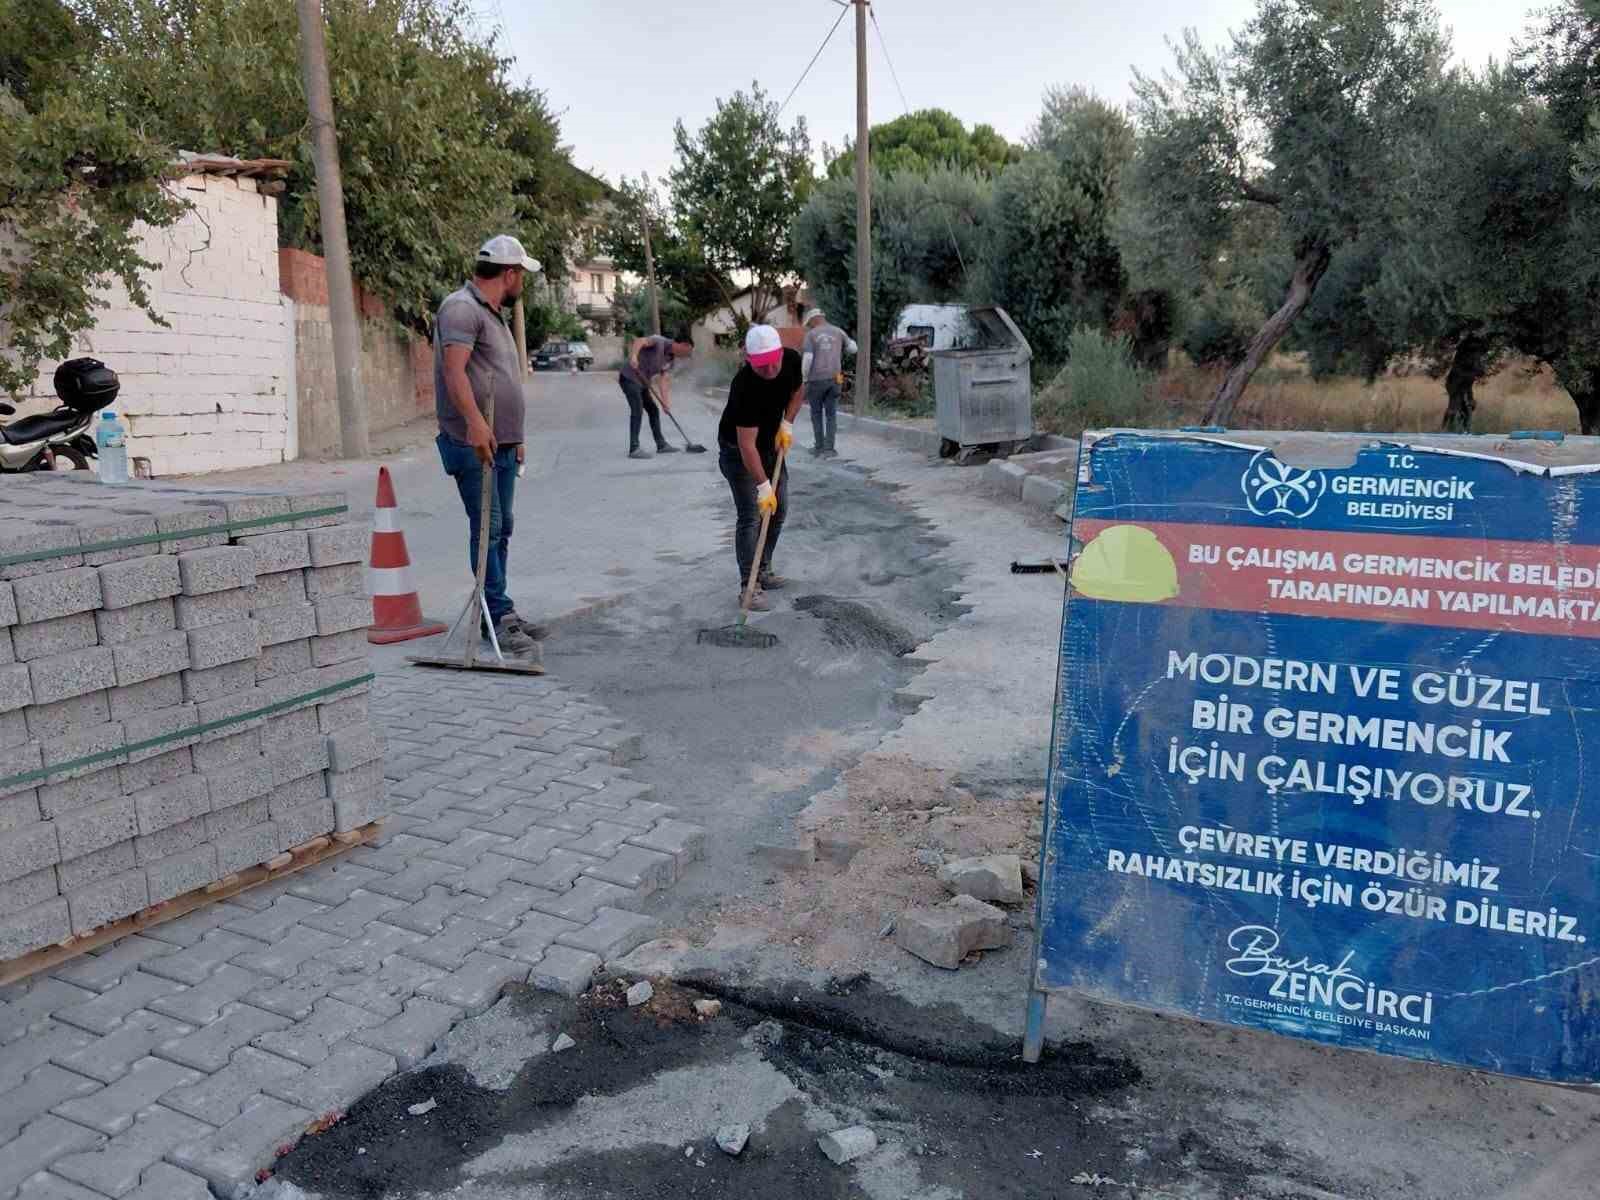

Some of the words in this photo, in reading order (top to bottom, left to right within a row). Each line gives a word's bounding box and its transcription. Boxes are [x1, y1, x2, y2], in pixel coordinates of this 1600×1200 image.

[1331, 476, 1475, 500] GERMENCİK
[1387, 454, 1420, 469] T.C.
[1347, 501, 1454, 521] BELEDİYESİ
[1188, 544, 1221, 564] BU
[1226, 547, 1337, 574] ÇALIŞMA
[1343, 553, 1502, 582] GERMENCİK
[1267, 579, 1429, 609] TARAFINDAN
[1167, 650, 1337, 695] MODERN
[1350, 666, 1401, 701] VE
[1412, 668, 1551, 716] GÜZEL
[1192, 694, 1254, 735] BİR
[1263, 707, 1513, 763] GERMENCİK
[1168, 736, 1247, 785] İÇİN
[1256, 754, 1542, 820] ÇALIŞIYORUZ.
[1178, 825, 1308, 865] ÇEVREYE
[1315, 842, 1500, 892] VERDİĞİMİZ
[1107, 849, 1284, 897] RAHATSIZLIK
[1291, 870, 1354, 908] İÇİN
[1360, 881, 1447, 922] ÖZÜR
[1455, 897, 1588, 944] DİLERİZ.
[1225, 925, 1366, 984] Burak
[1268, 968, 1433, 1025] ZENCİRCİ
